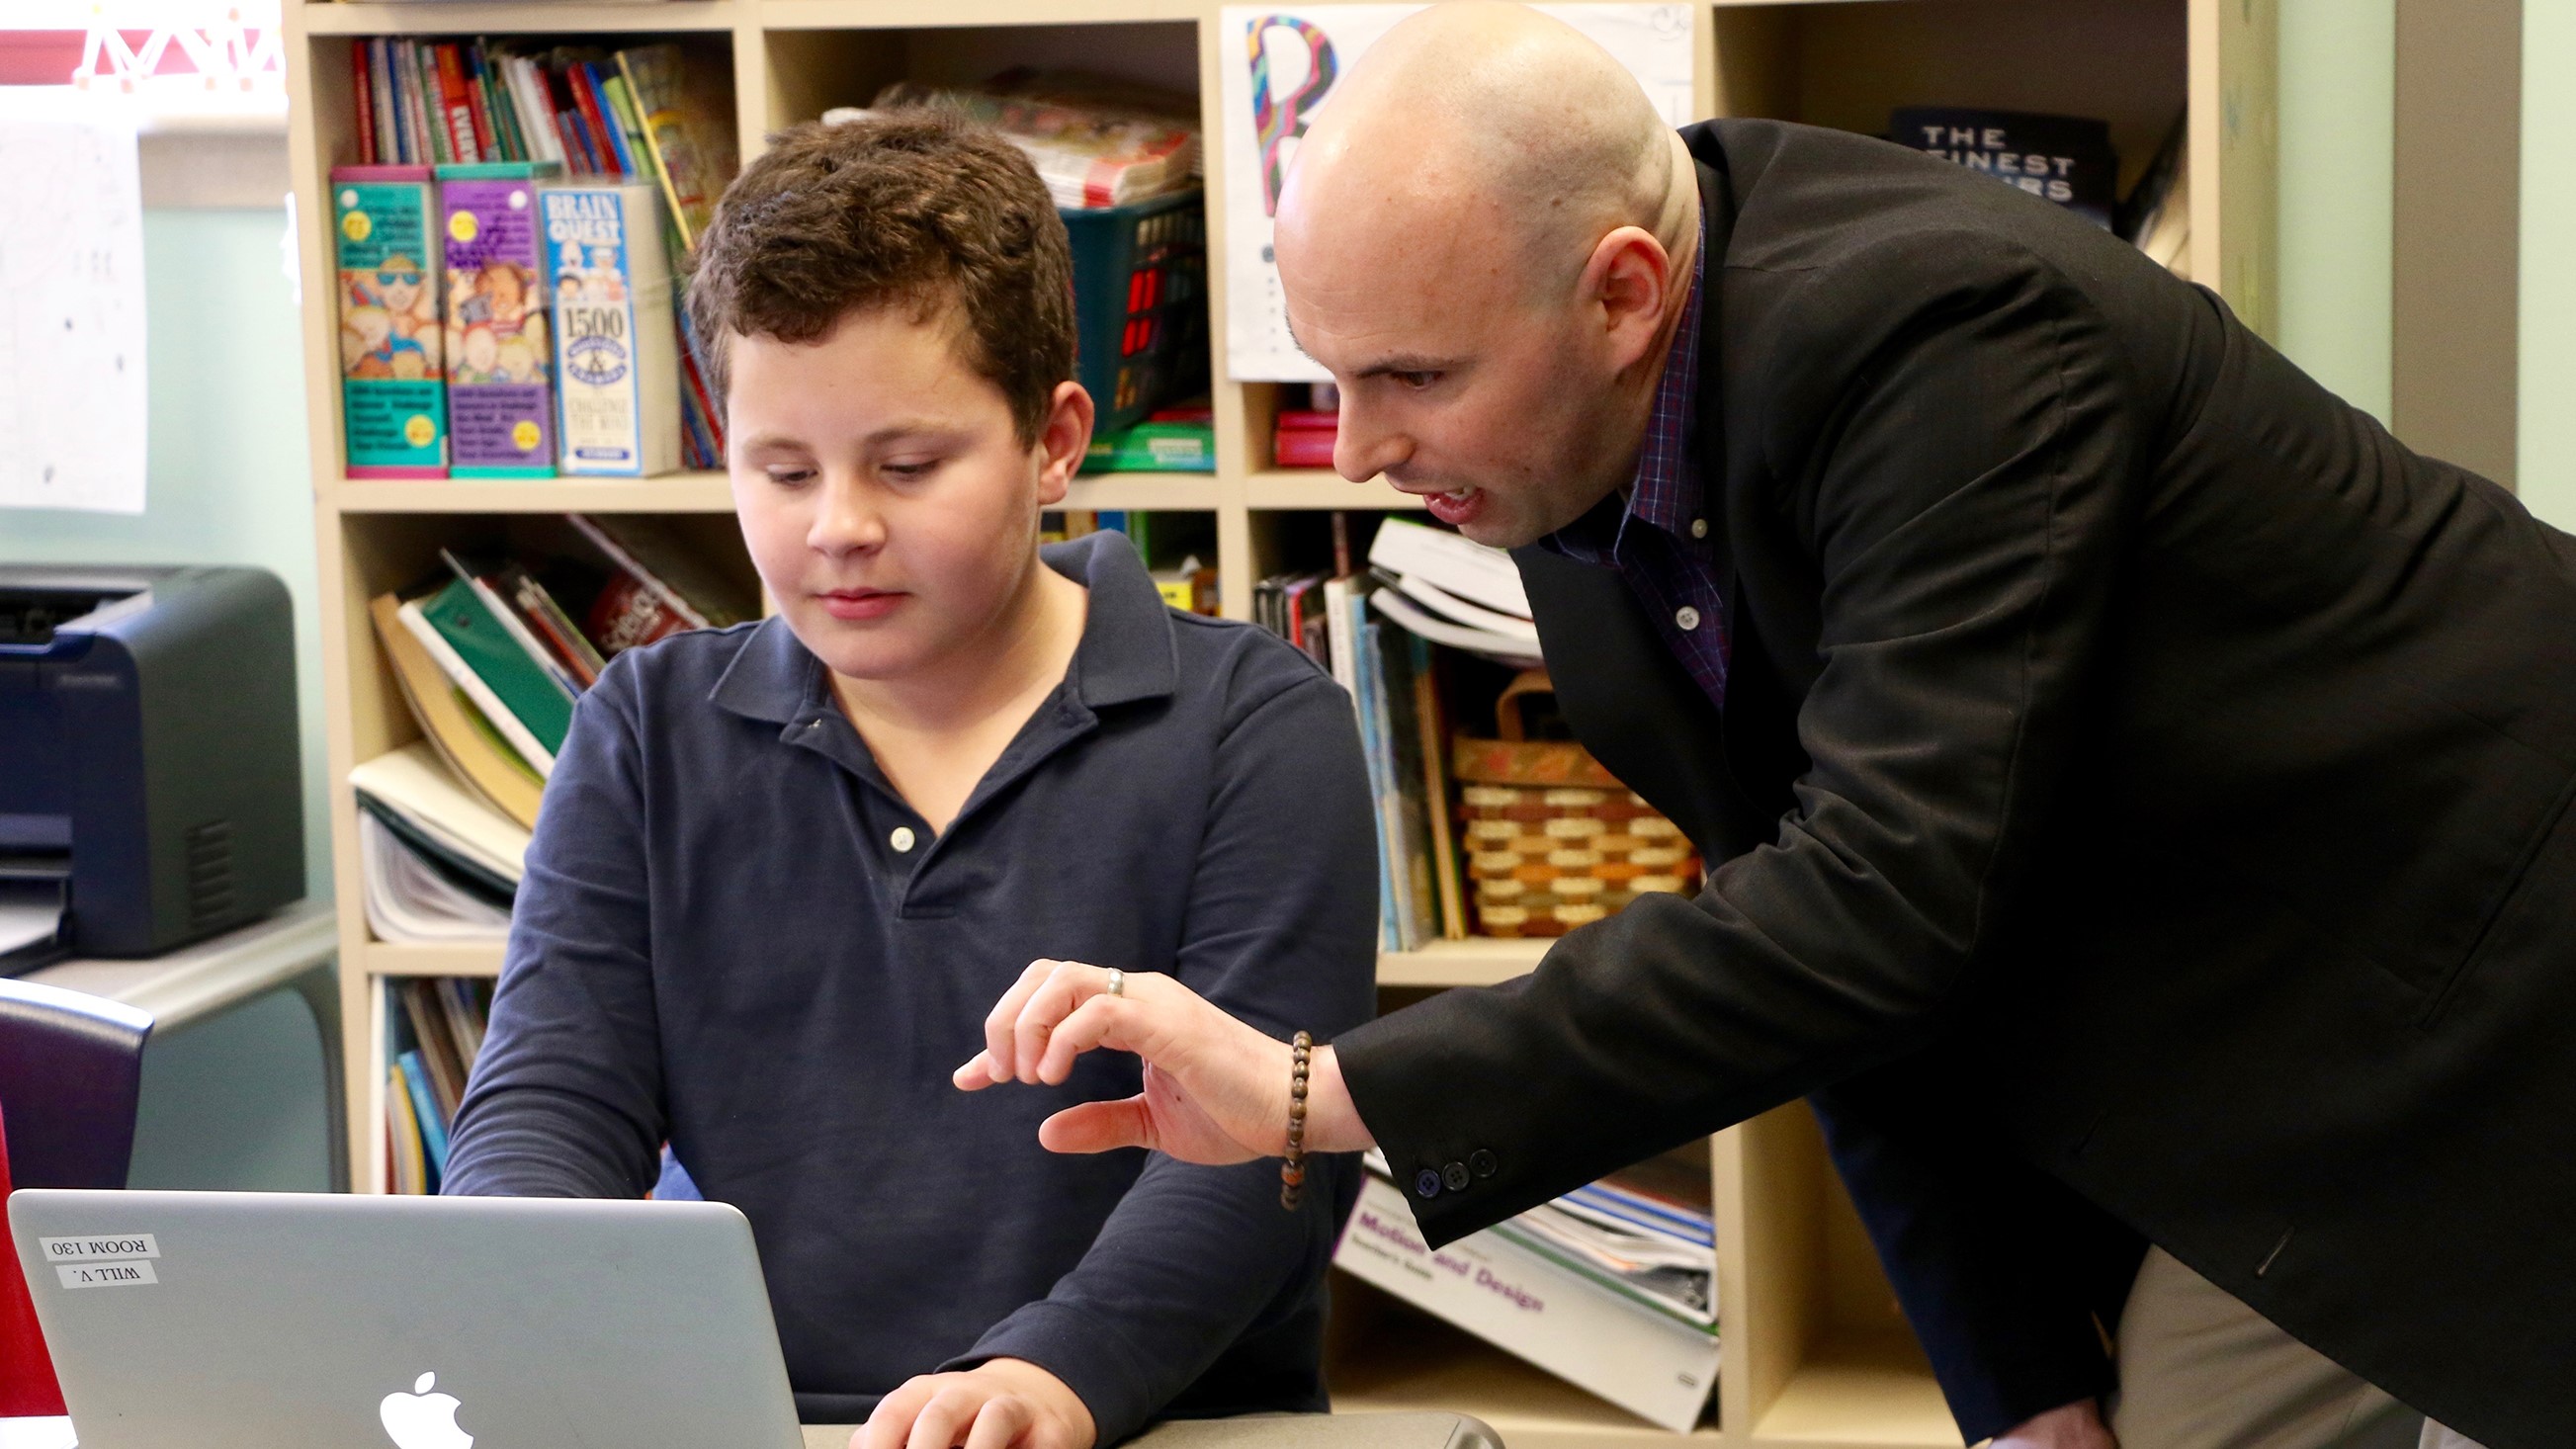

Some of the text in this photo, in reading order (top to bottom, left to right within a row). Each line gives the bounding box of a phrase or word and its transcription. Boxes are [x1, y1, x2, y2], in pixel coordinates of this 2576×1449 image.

[1922, 126, 2006, 149] THE
[1926, 149, 2076, 177] INEST
[546, 195, 618, 220] BRAIN
[549, 220, 621, 246] QUEST
[564, 307, 624, 338] 1500
[51, 1240, 148, 1256] ROOM 130
[73, 1267, 141, 1282] WILL V.
[1359, 1212, 1425, 1256] Motion
[1433, 1252, 1472, 1277] and
[1476, 1268, 1545, 1312] Design
